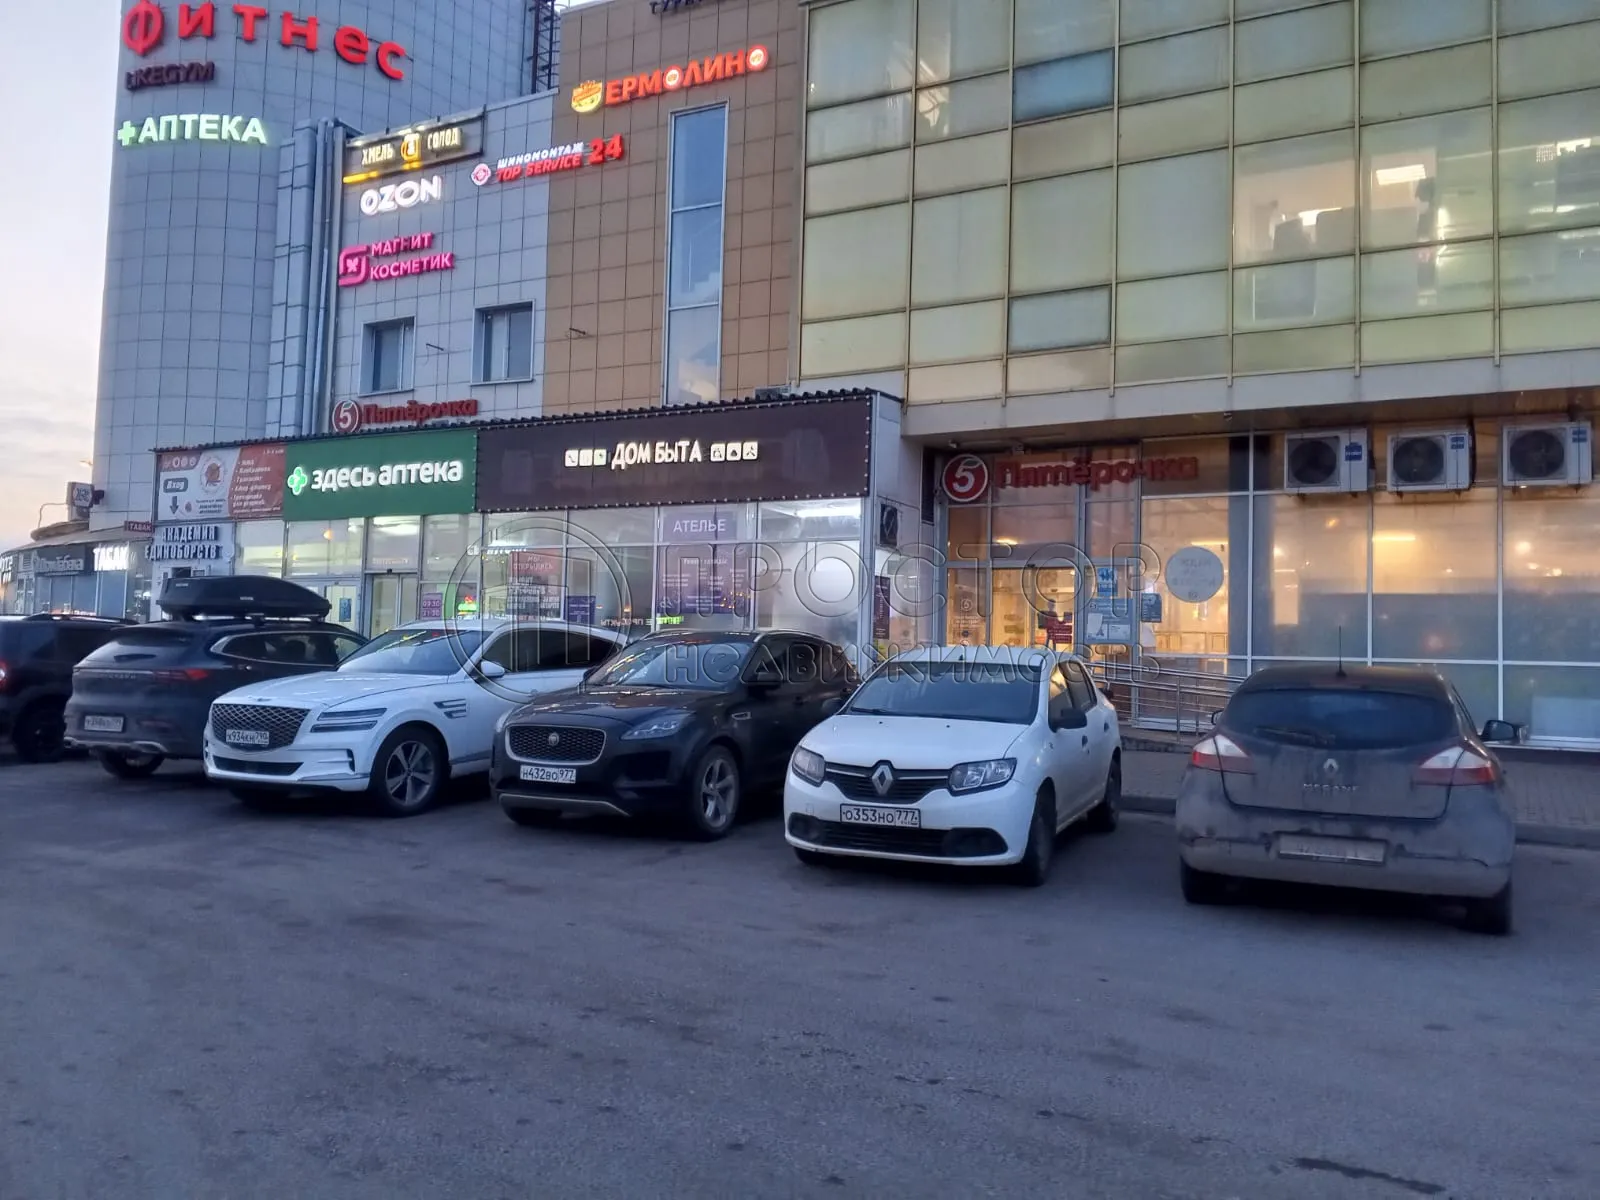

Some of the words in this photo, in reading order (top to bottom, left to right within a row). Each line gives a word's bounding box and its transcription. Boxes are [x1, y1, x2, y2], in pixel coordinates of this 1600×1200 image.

[604, 44, 769, 104] ЕРМОЛИНО
[138, 114, 267, 145] АПТЕКА
[497, 142, 584, 168] ШИНОМОНТАЖ
[589, 133, 624, 165] 24
[496, 166, 522, 181] TOP
[526, 153, 582, 177] SERVICE
[360, 175, 441, 216] OZON
[371, 232, 433, 258] МАГНИТ
[370, 253, 453, 280] КОСМЕТИК
[362, 399, 477, 426] Пятёрочка
[611, 442, 650, 470] ДОМ
[654, 440, 702, 463] БЫТА
[311, 467, 375, 492] здесь
[378, 460, 463, 486] аптека
[994, 456, 1198, 491] Пятёрочка
[161, 526, 216, 542] АКАДЕМИЯ
[673, 519, 726, 533] АТЕЛЬЕ
[145, 545, 217, 561] ЕДИНОБОРСТВ
